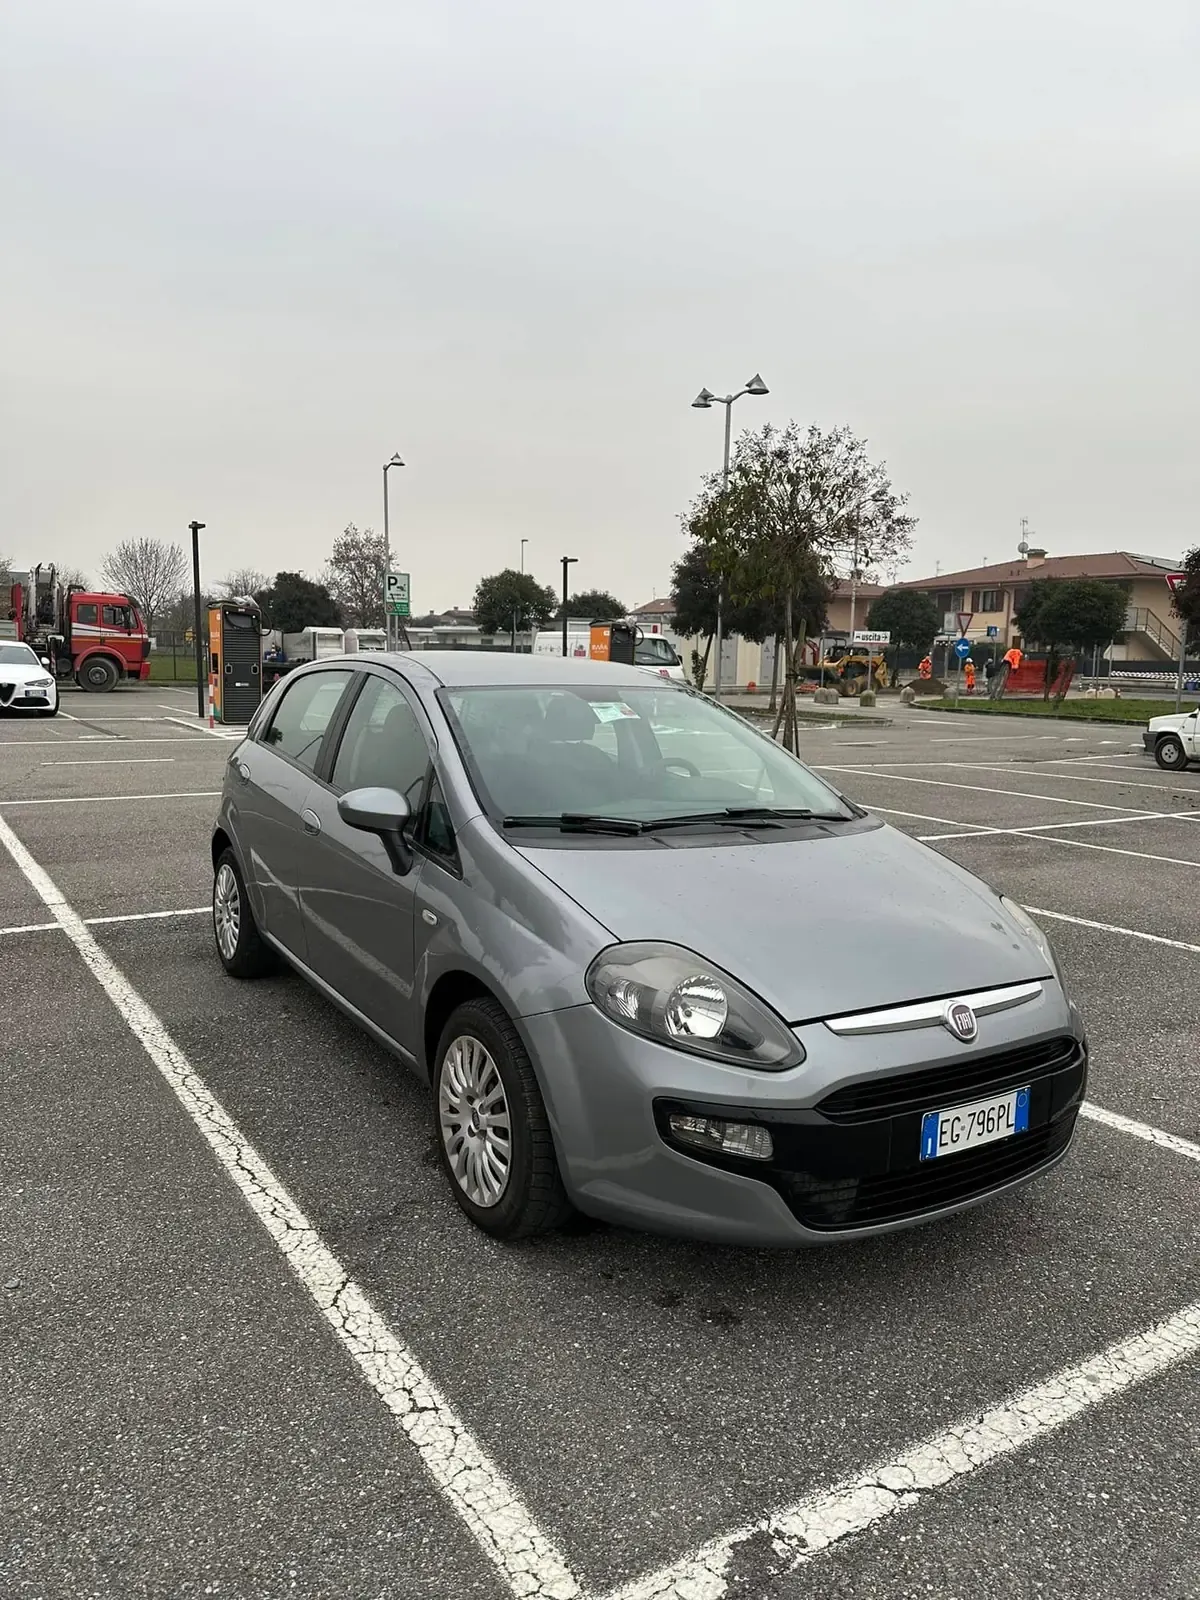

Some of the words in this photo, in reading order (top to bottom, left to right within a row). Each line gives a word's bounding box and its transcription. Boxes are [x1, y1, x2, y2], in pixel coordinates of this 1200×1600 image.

[388, 576, 397, 591] P
[862, 633, 881, 641] uscita
[955, 1012, 973, 1030] FIAT
